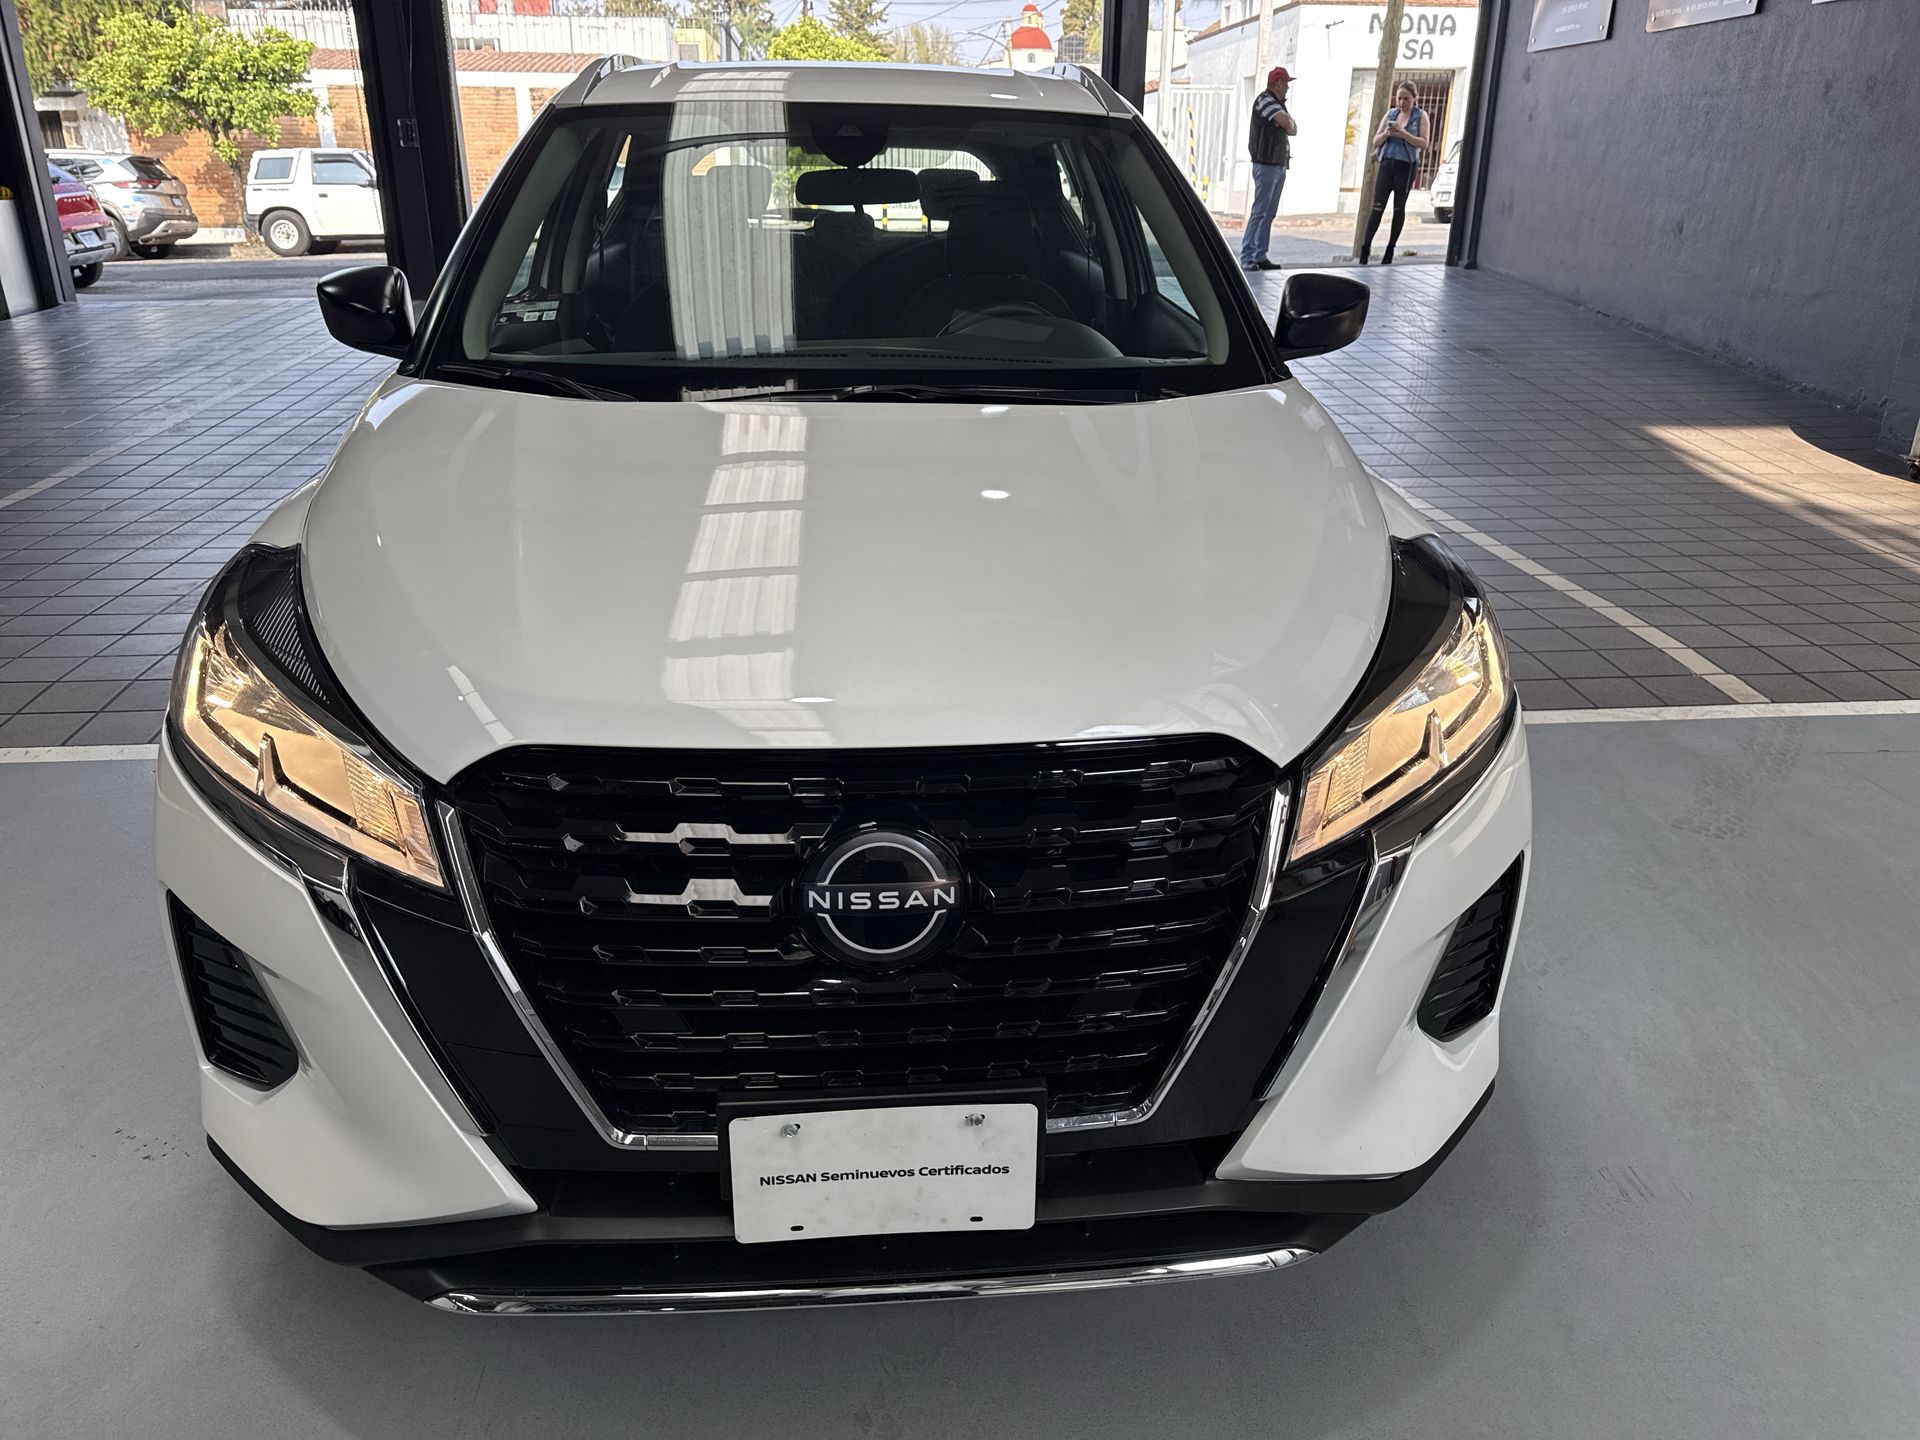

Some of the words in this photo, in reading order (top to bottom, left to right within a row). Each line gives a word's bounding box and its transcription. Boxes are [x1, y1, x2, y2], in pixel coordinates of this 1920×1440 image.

[1369, 13, 1456, 36] MONA
[808, 886, 955, 910] NISSAN
[760, 1173, 816, 1186] NISSAN
[821, 1169, 915, 1181] Seminuevos
[919, 1165, 1009, 1176] Certificados
